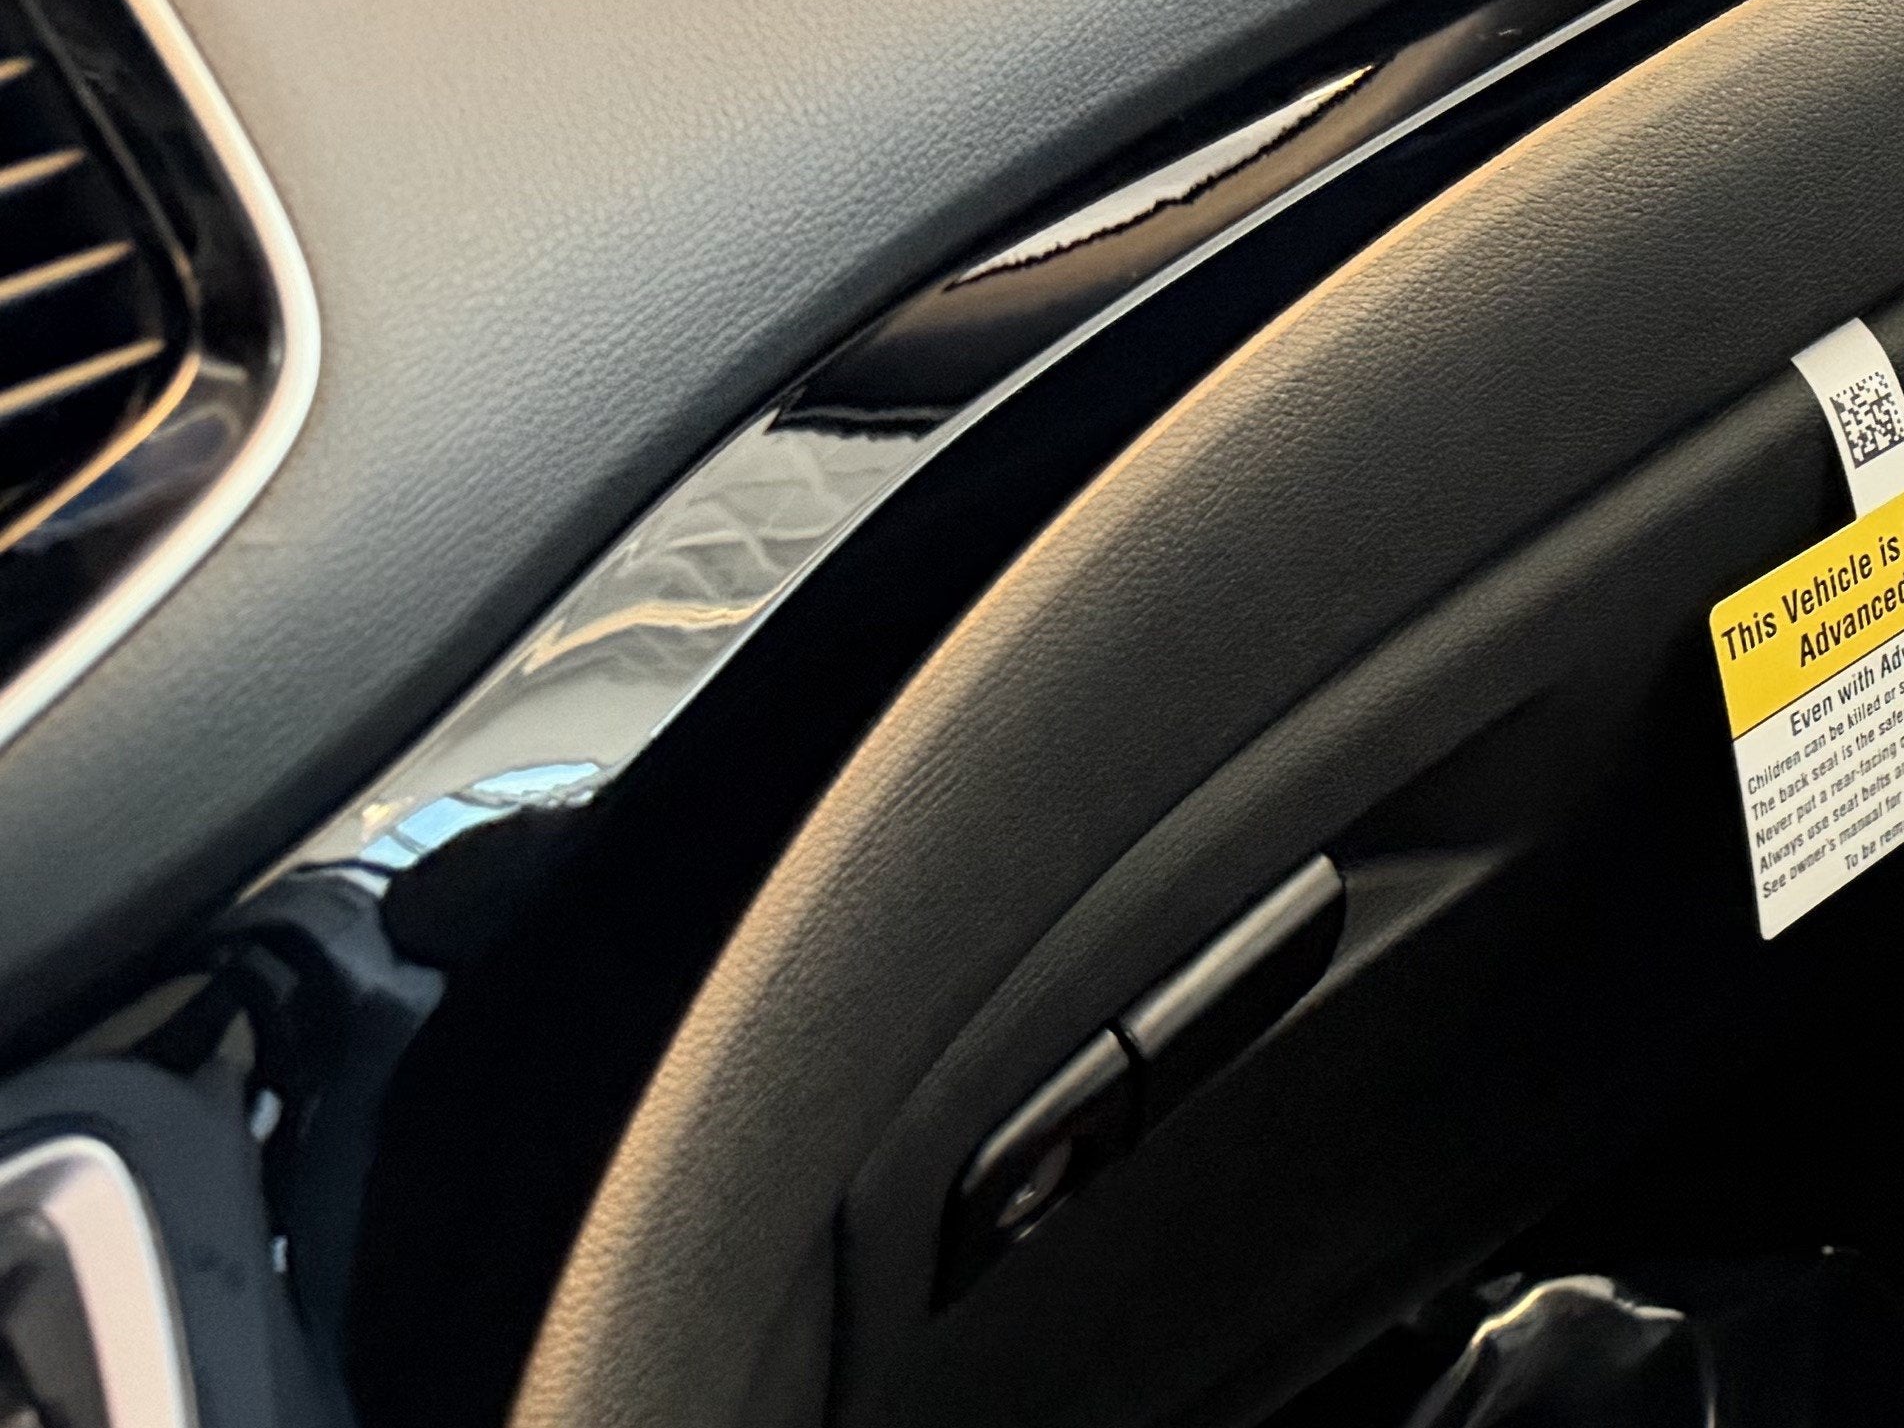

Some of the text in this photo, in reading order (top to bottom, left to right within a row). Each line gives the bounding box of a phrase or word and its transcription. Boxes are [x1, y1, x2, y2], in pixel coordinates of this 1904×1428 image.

[1721, 612, 1778, 661] This
[1782, 553, 1873, 623] Vehicle
[1879, 536, 1900, 567] is
[1748, 750, 1801, 795] Children
[1804, 734, 1826, 758] can
[1828, 722, 1844, 742] be
[1847, 694, 1881, 730] killed
[1884, 687, 1896, 705] or
[1789, 696, 1833, 736] Even
[1837, 665, 1875, 705] with
[1751, 796, 1776, 821] The
[1779, 773, 1809, 804] back
[1812, 751, 1839, 781] seat
[1842, 744, 1853, 761] is
[1855, 729, 1875, 751] the
[1756, 812, 1794, 848] Never
[1796, 795, 1817, 823] put
[1820, 790, 1828, 804] a
[1831, 742, 1897, 797] rear-facing
[1760, 833, 1804, 873] Always
[1807, 816, 1829, 840] use
[1833, 793, 1859, 822] seat
[1861, 773, 1892, 802] belts
[1762, 874, 1786, 899] See
[1790, 836, 1836, 880] owner's
[1839, 802, 1883, 845] manual
[1885, 791, 1901, 812] for
[1844, 853, 1859, 870] To
[1861, 840, 1876, 860] be
